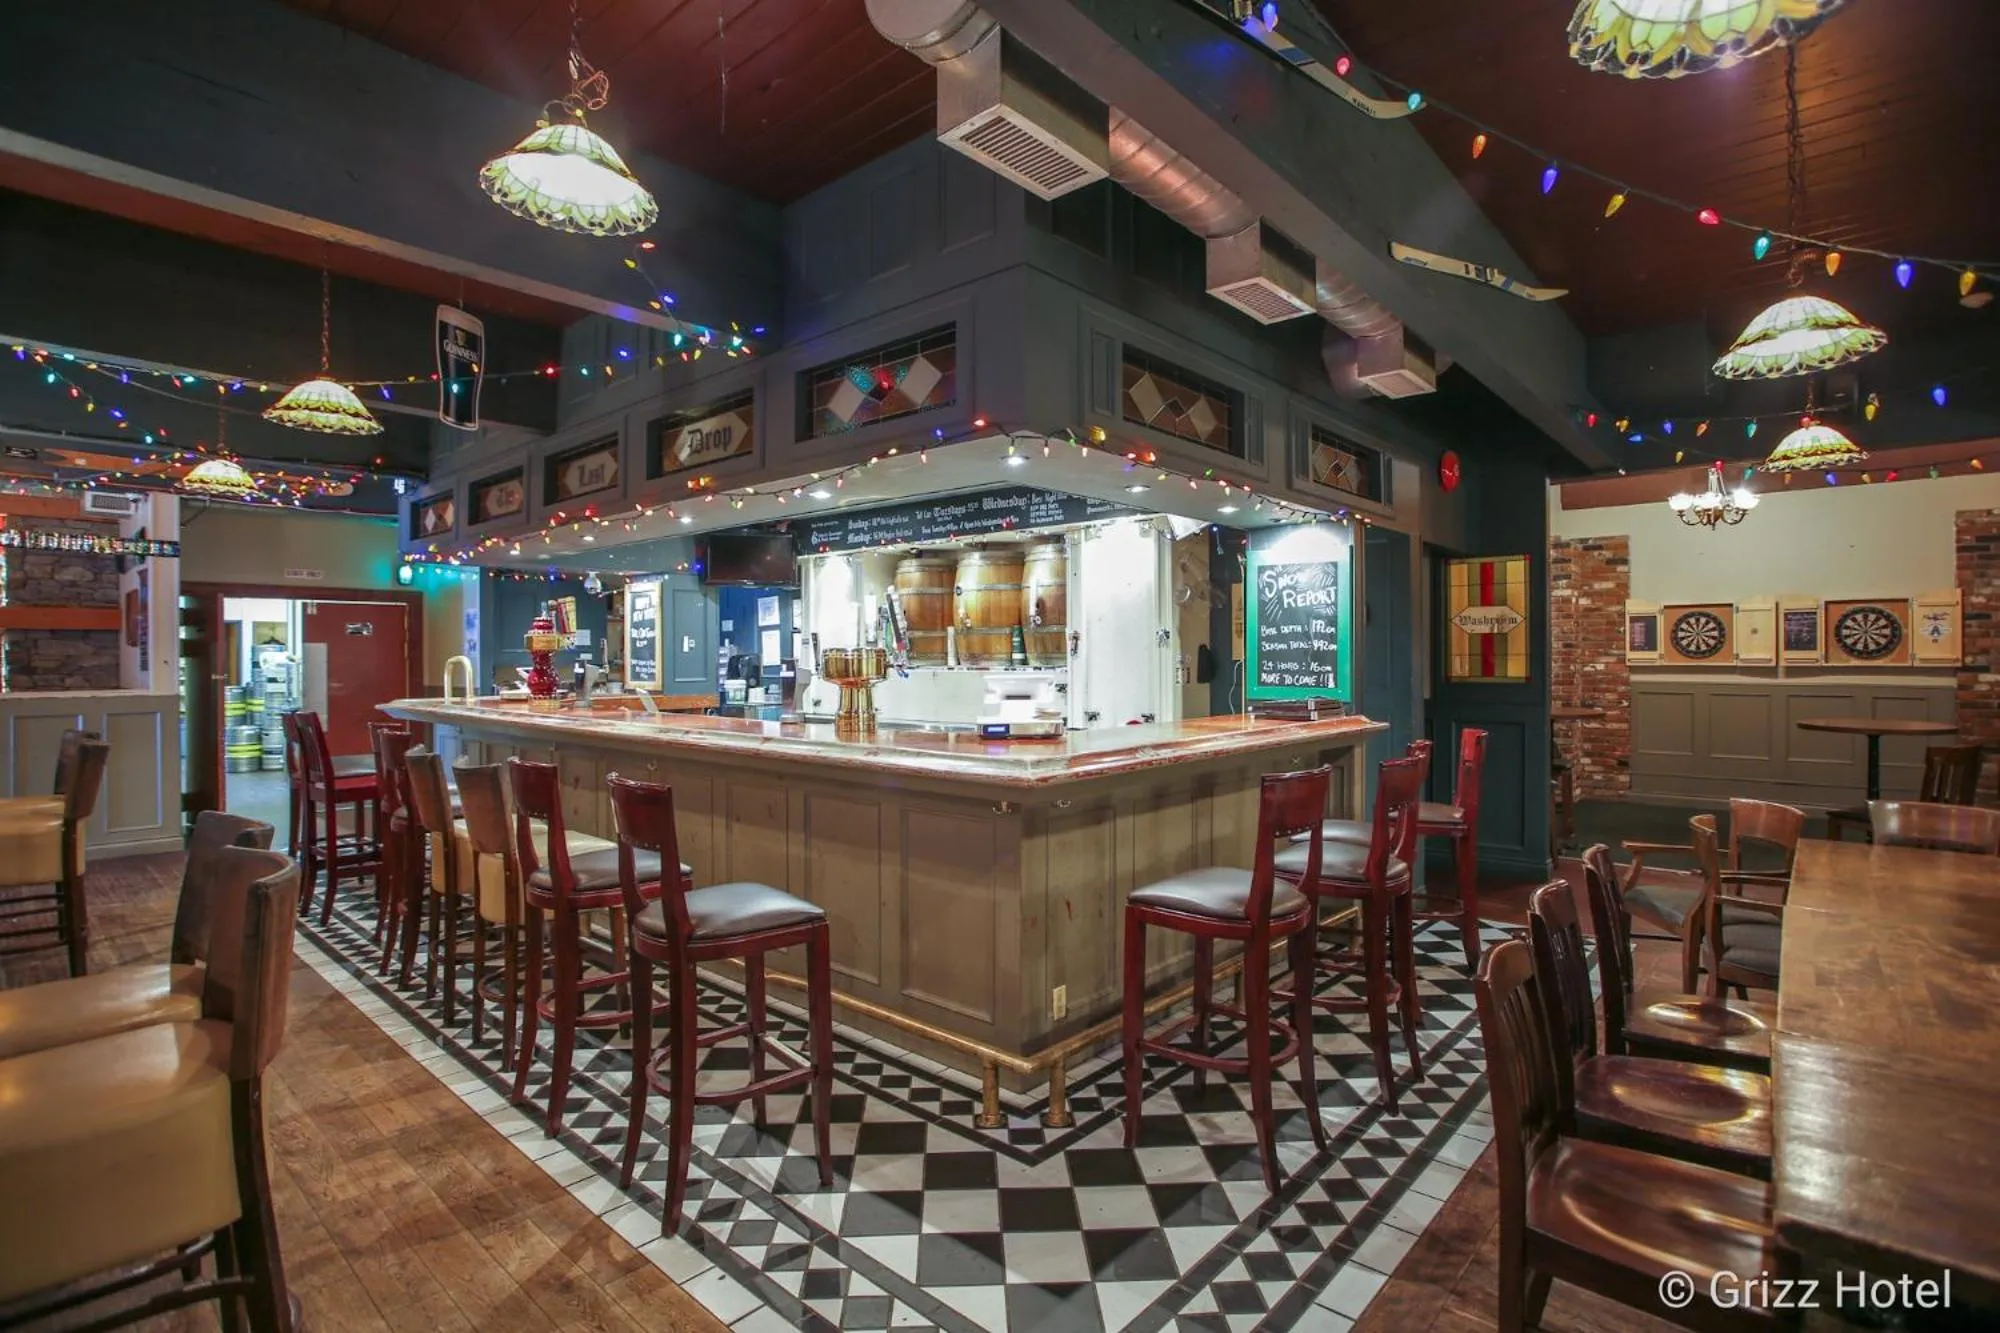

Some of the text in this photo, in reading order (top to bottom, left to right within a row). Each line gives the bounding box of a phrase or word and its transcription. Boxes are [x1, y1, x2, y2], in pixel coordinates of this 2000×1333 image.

[687, 425, 733, 454] Drop
[1282, 585, 1337, 609] REPORT
[1260, 671, 1282, 685] MORE
